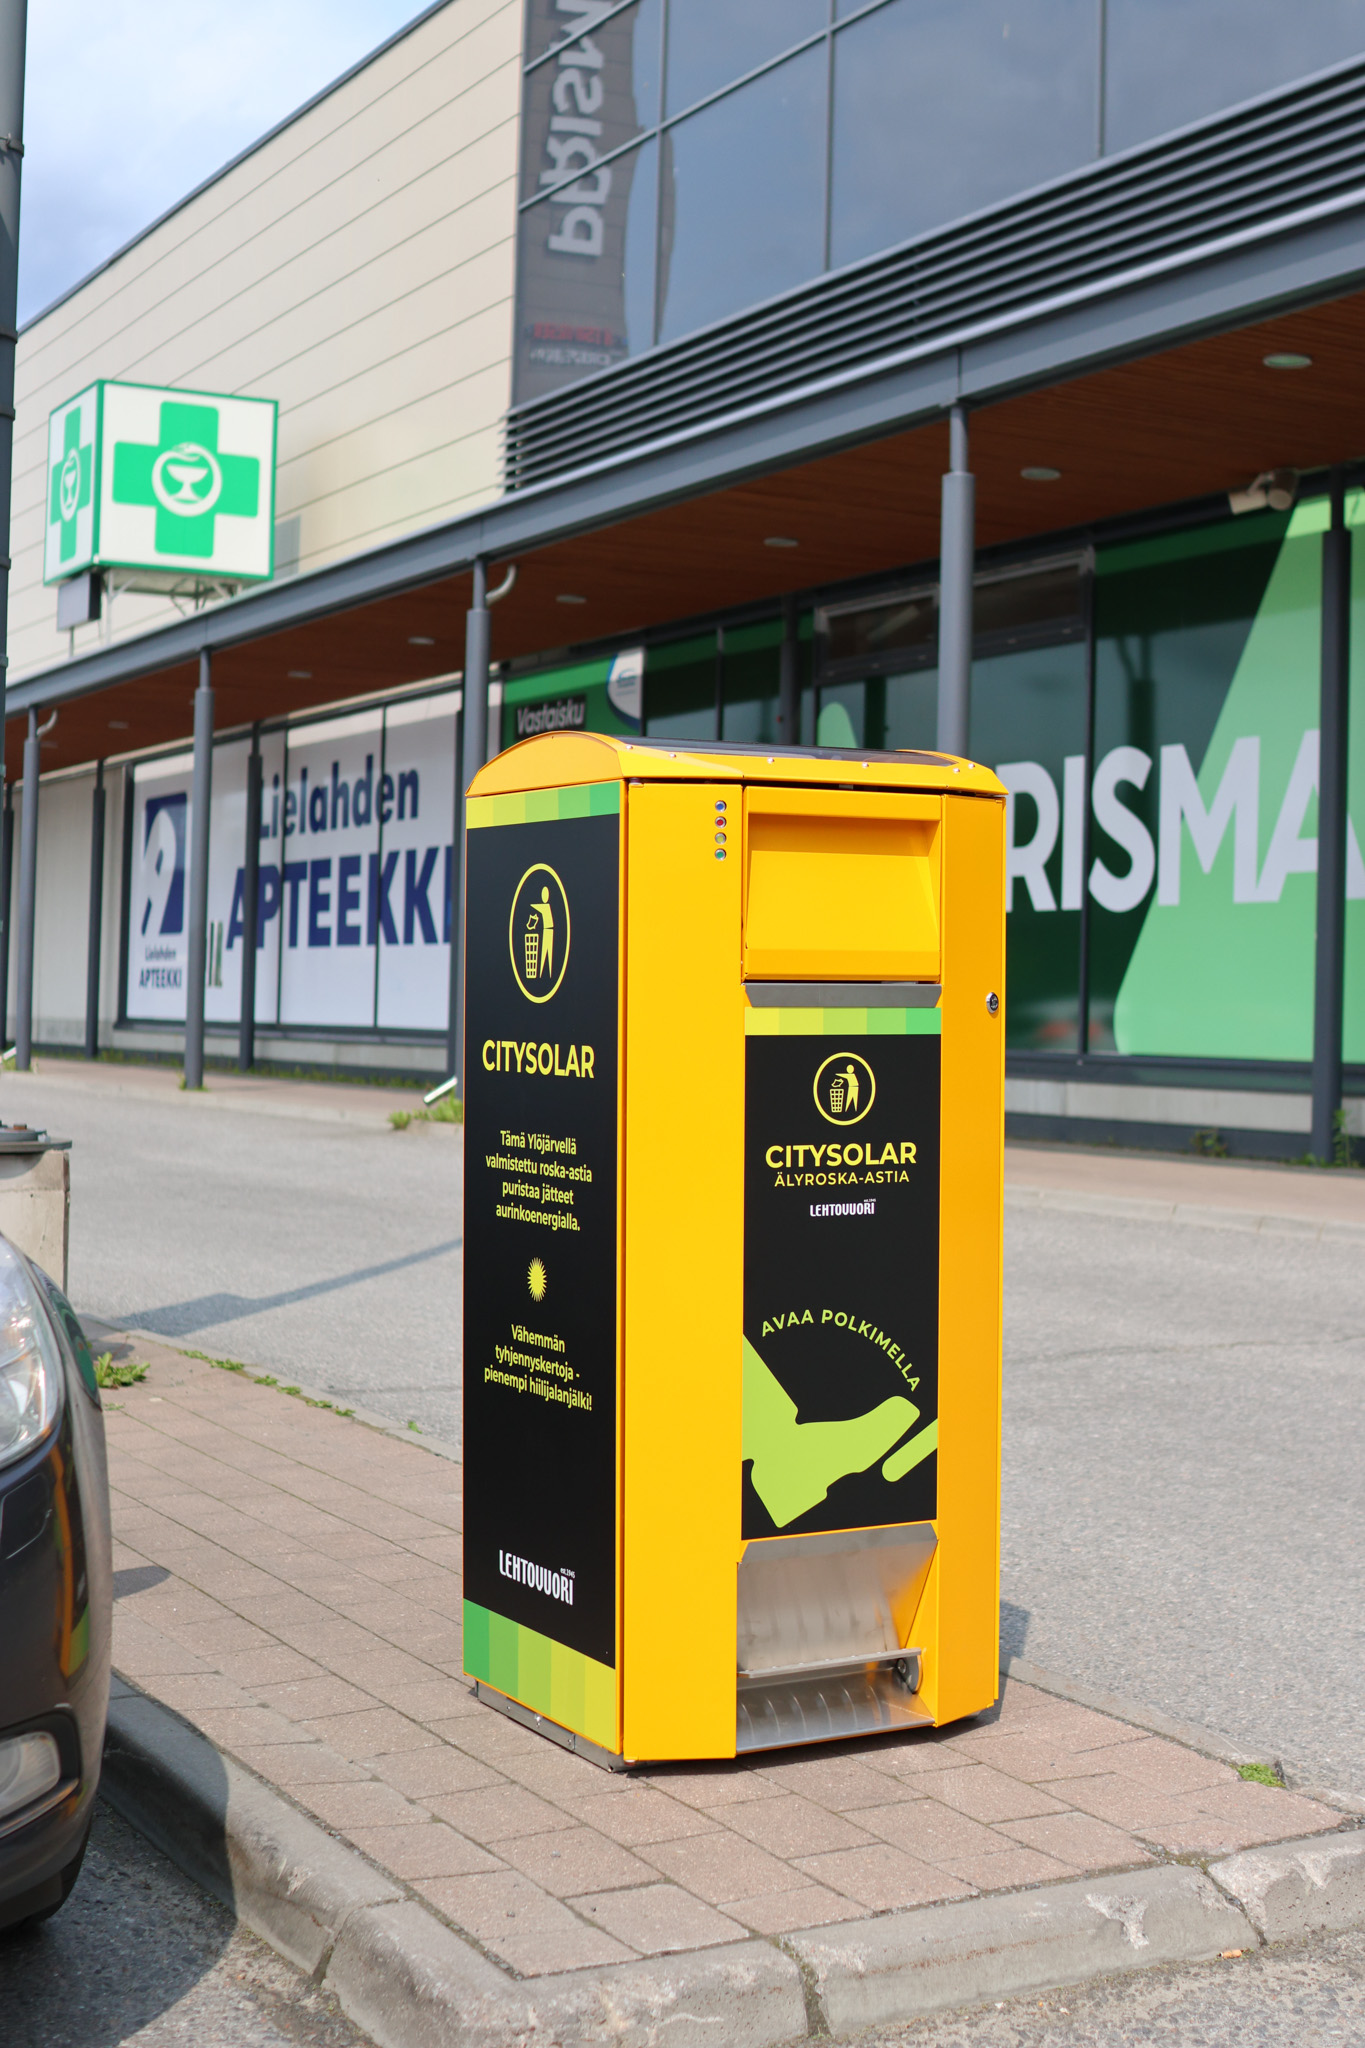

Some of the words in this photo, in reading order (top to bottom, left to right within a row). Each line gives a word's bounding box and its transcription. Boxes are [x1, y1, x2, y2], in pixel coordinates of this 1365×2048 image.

[517, 698, 585, 735] Vastaisku
[139, 967, 182, 988] APTEEKKI
[482, 1039, 595, 1079] CITYSOLAR
[500, 1130, 526, 1148] Tämä
[527, 1133, 577, 1155] Ylöjärvellä
[765, 1142, 917, 1169] CITYSOLAR
[485, 1152, 537, 1174] valmistettu
[539, 1160, 592, 1183] roska-astia
[774, 1170, 910, 1187] ÄLYROSKA-ASTIA
[502, 1179, 540, 1200] puristaa
[541, 1183, 574, 1205] jätteet
[495, 1202, 580, 1231] aurinkoenergialla.
[809, 1202, 875, 1217] LEHTOVUORI
[511, 1323, 566, 1353] Vähemmän
[762, 1309, 814, 1337] AVAA
[821, 1309, 921, 1392] POLKIMELLA
[495, 1344, 574, 1383] tyhjennyskertoja
[484, 1364, 528, 1393] pienempi
[529, 1376, 593, 1411] hiilijalanjälki!
[499, 1549, 574, 1606] LEHTOVUORI
